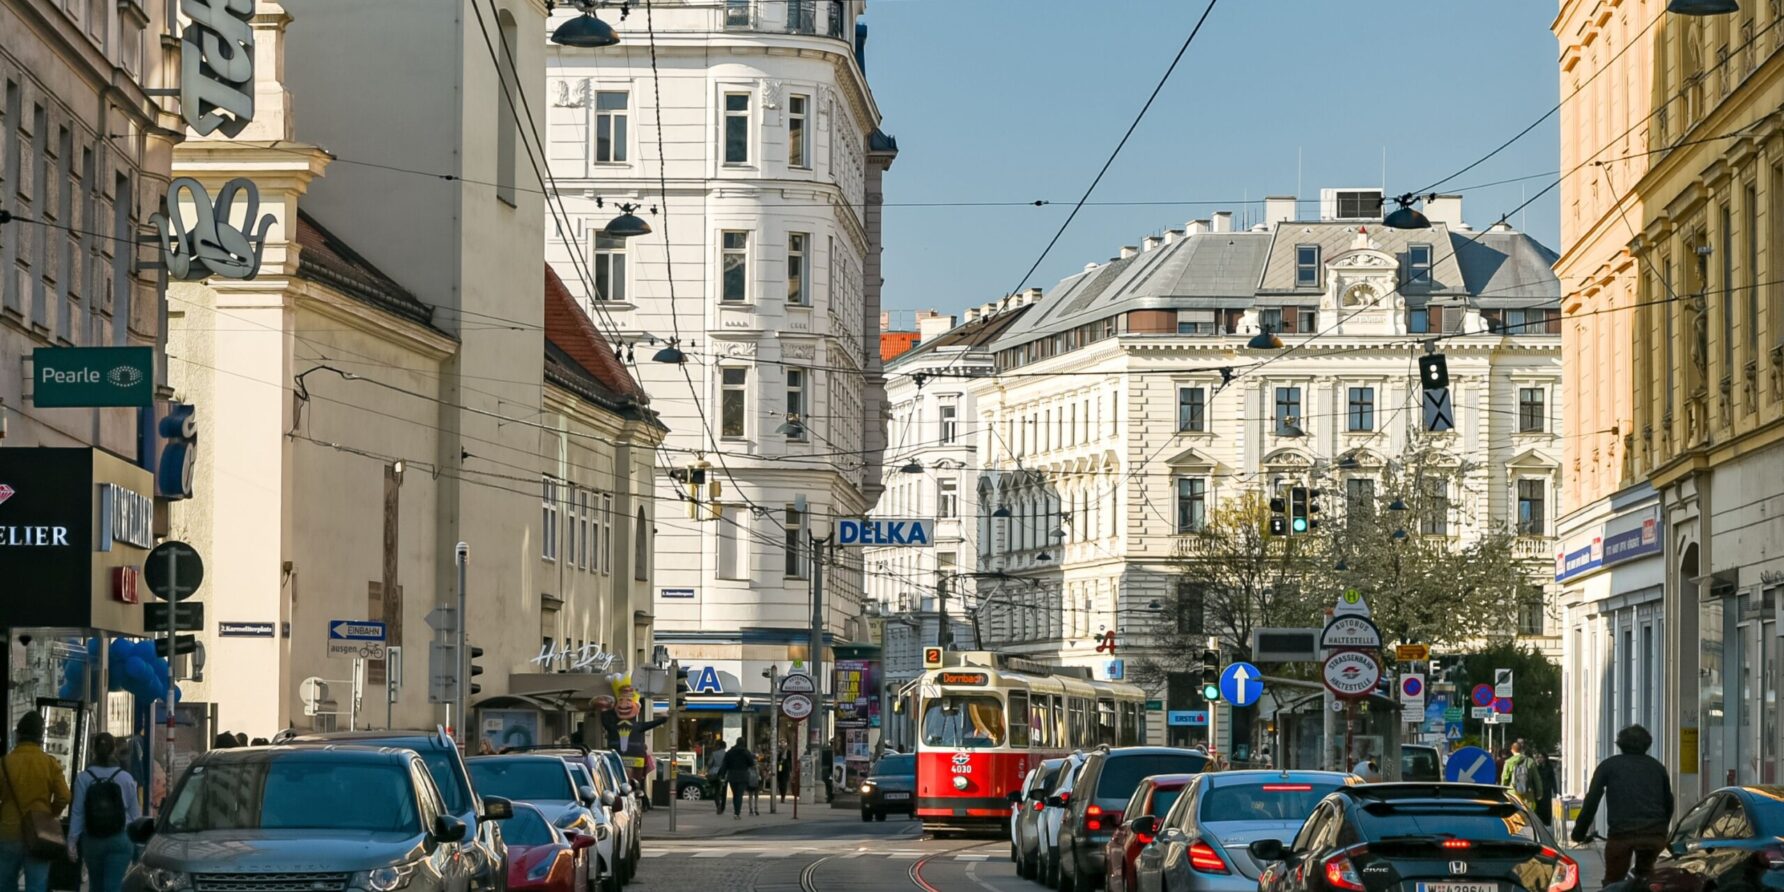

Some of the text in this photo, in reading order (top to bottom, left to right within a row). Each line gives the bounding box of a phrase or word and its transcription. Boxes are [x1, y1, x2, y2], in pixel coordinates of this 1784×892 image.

[42, 367, 100, 383] Pearle
[840, 521, 927, 544] DELKA
[1347, 591, 1356, 601] H
[348, 626, 380, 635] EINBAHN
[1335, 620, 1369, 632] AUTOBUS
[530, 641, 616, 671] Hot-Dog
[928, 651, 938, 661] 2
[1328, 654, 1374, 670] STRASSENBAHN
[943, 672, 984, 683] Dornbach
[1330, 677, 1371, 690] HALTESTELLE
[1334, 702, 1340, 710] 2
[951, 765, 972, 773] 4030
